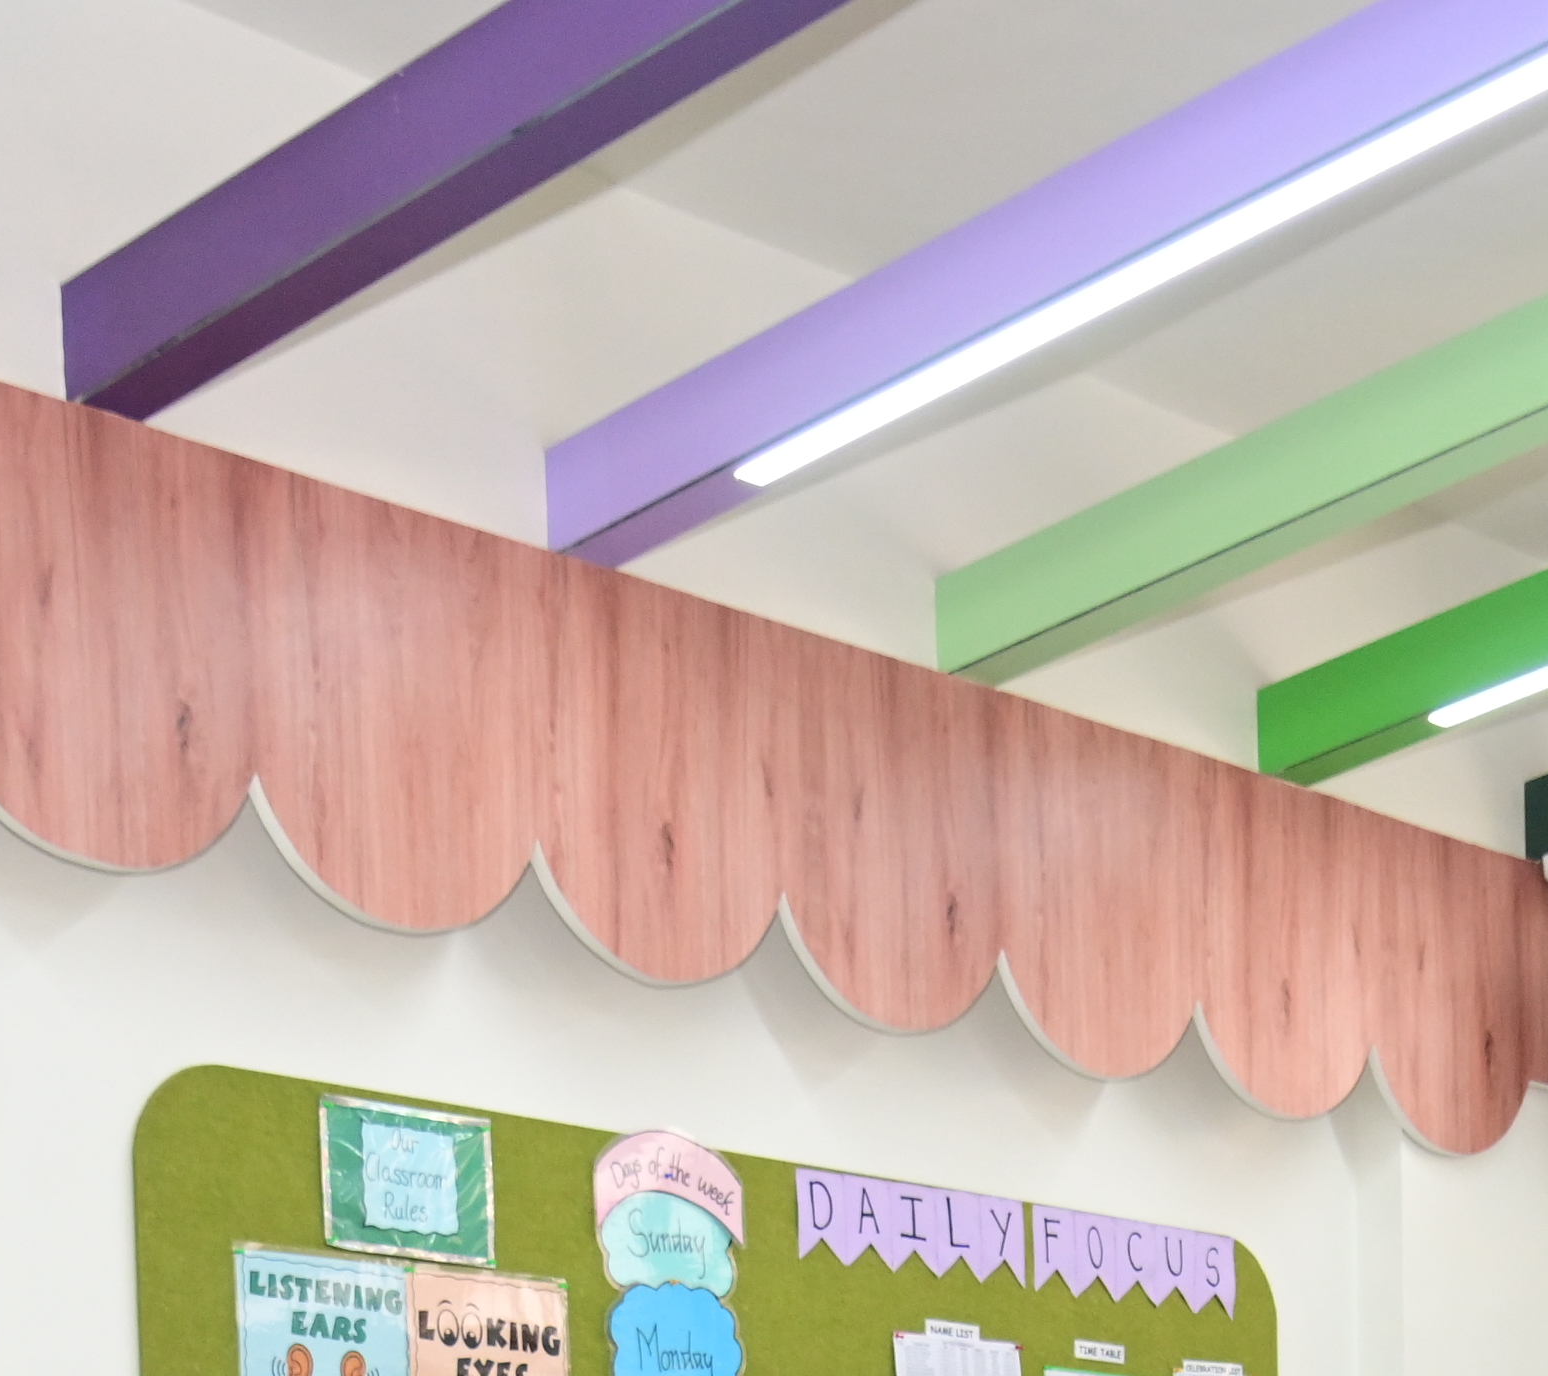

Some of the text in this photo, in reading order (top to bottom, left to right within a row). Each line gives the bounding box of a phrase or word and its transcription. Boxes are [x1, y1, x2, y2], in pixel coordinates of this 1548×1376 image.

[392, 1129, 419, 1153] Our
[610, 1147, 734, 1216] Days of the week
[384, 1191, 428, 1223] Rules
[627, 1209, 706, 1279] Sunday
[808, 1180, 1223, 1289] DAILY FOCUS
[249, 1271, 402, 1316] LISTENING
[291, 1311, 367, 1344] EARS
[418, 1308, 561, 1356] LOOKING
[930, 1325, 974, 1339] NAME LIST
[1079, 1346, 1122, 1360] TIME TABLE
